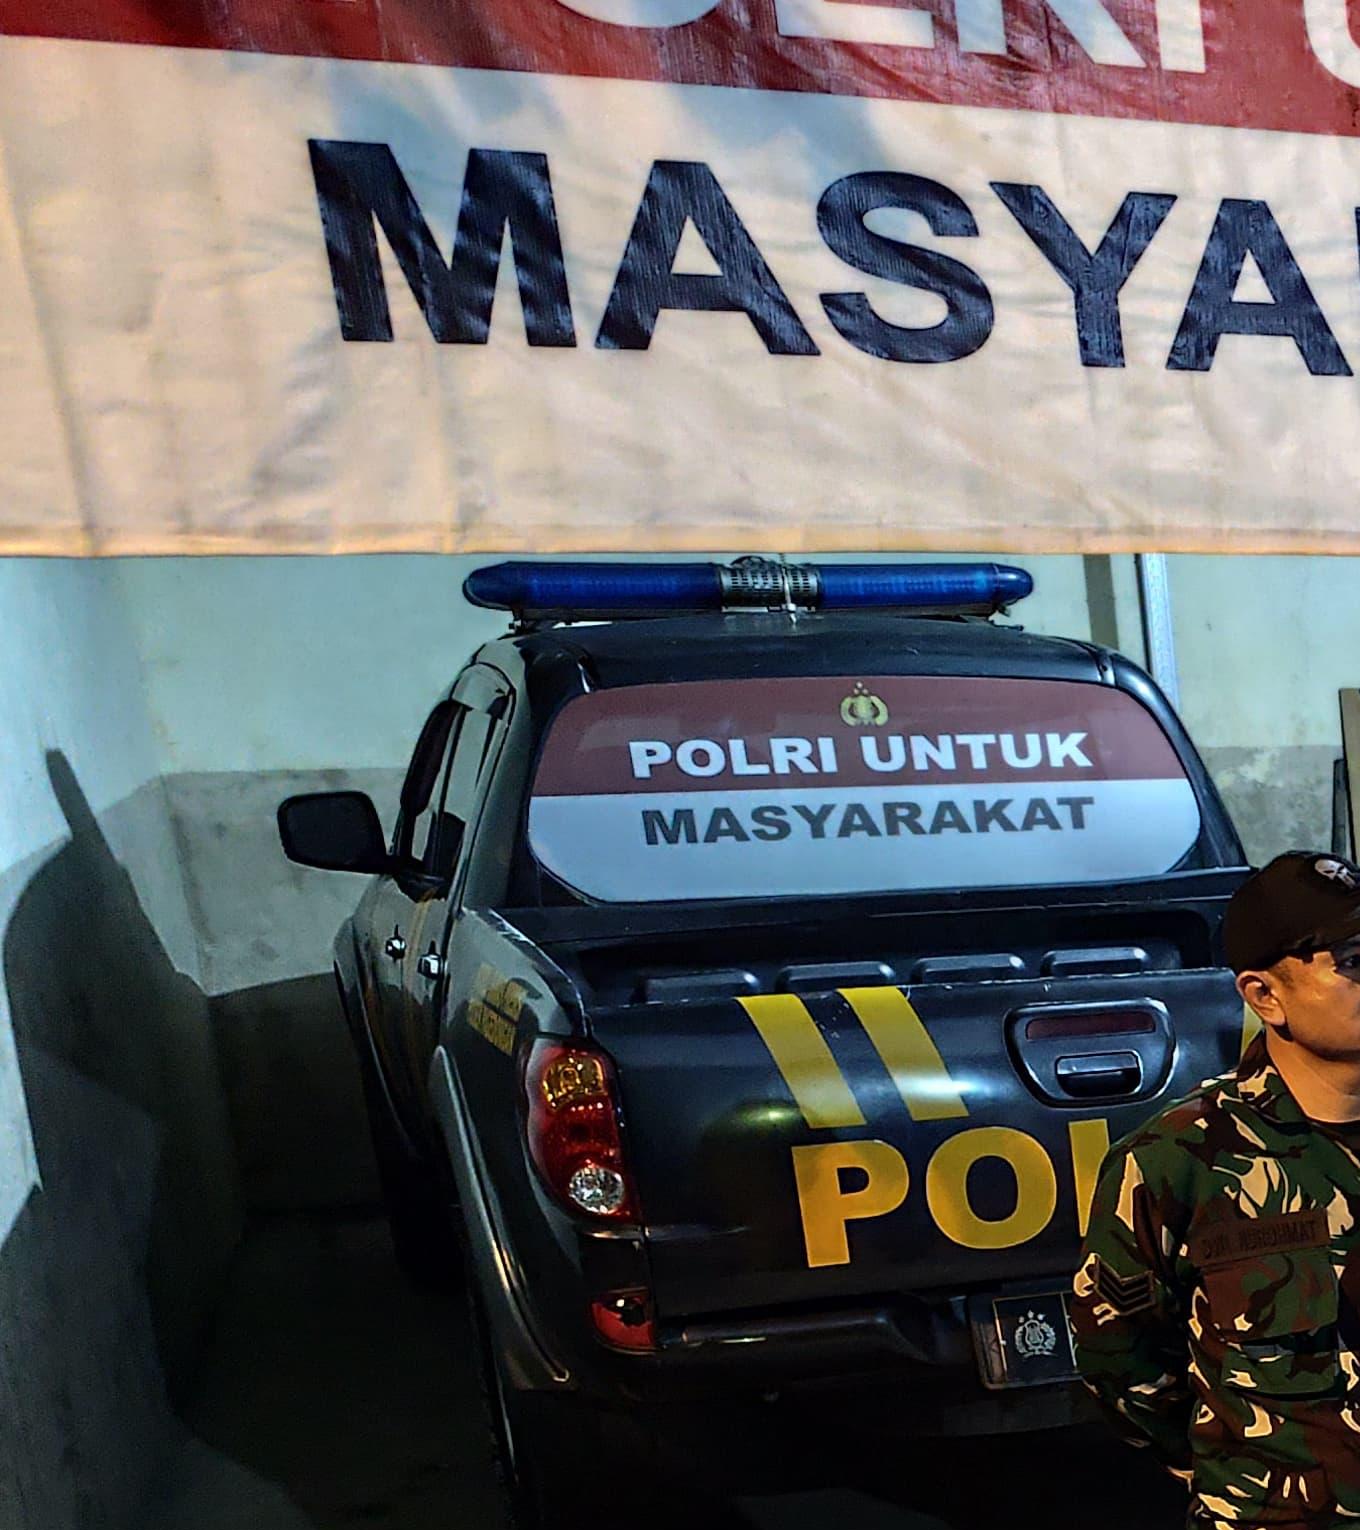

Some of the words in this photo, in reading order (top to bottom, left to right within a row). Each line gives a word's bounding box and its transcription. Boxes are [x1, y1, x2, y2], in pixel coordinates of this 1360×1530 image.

[628, 735, 840, 779] POLRI
[858, 731, 1094, 774] UNTUK
[640, 795, 1095, 846] MASYARAKAT
